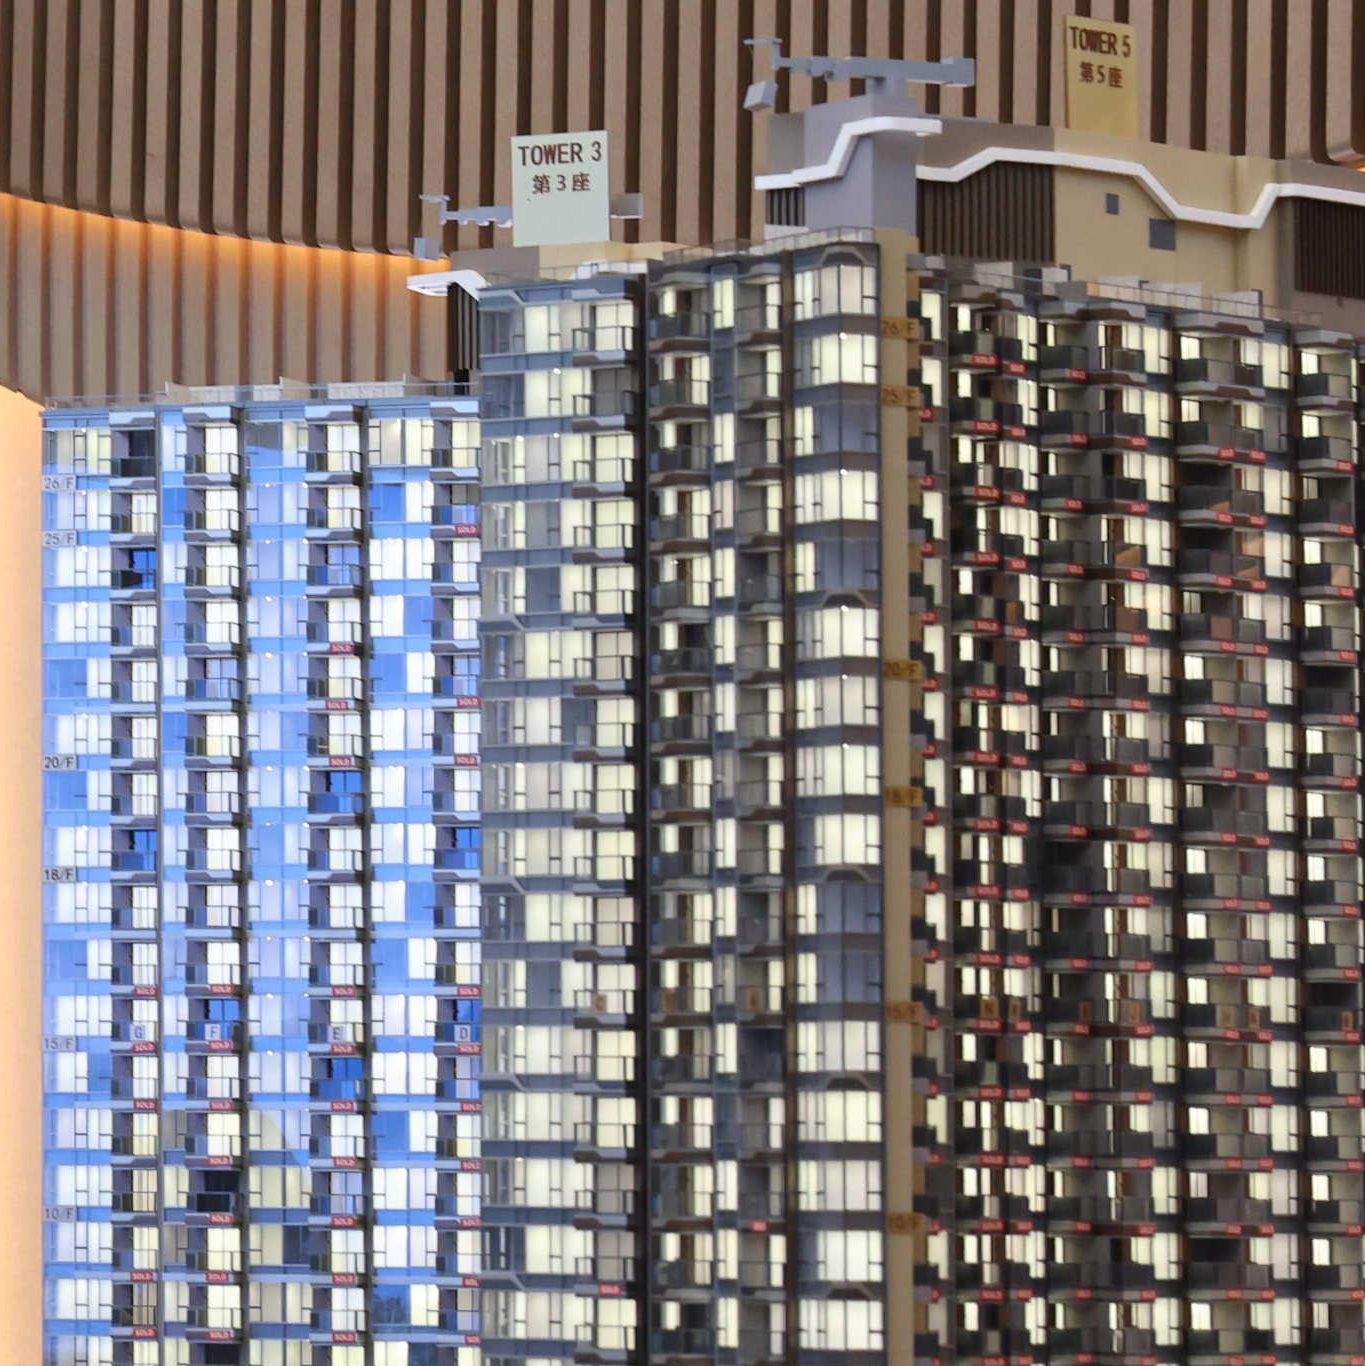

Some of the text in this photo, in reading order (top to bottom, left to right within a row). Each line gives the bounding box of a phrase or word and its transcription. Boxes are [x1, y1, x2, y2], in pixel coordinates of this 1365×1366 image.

[1070, 26, 1131, 58] TOWER 5
[517, 141, 602, 167] TOWER 3
[44, 476, 74, 489] 26/F
[44, 532, 74, 545] 25/F
[44, 756, 74, 769] 20/F
[44, 868, 74, 881] 18/F
[44, 1038, 73, 1049] 15/F
[45, 1207, 74, 1220] 10/F
